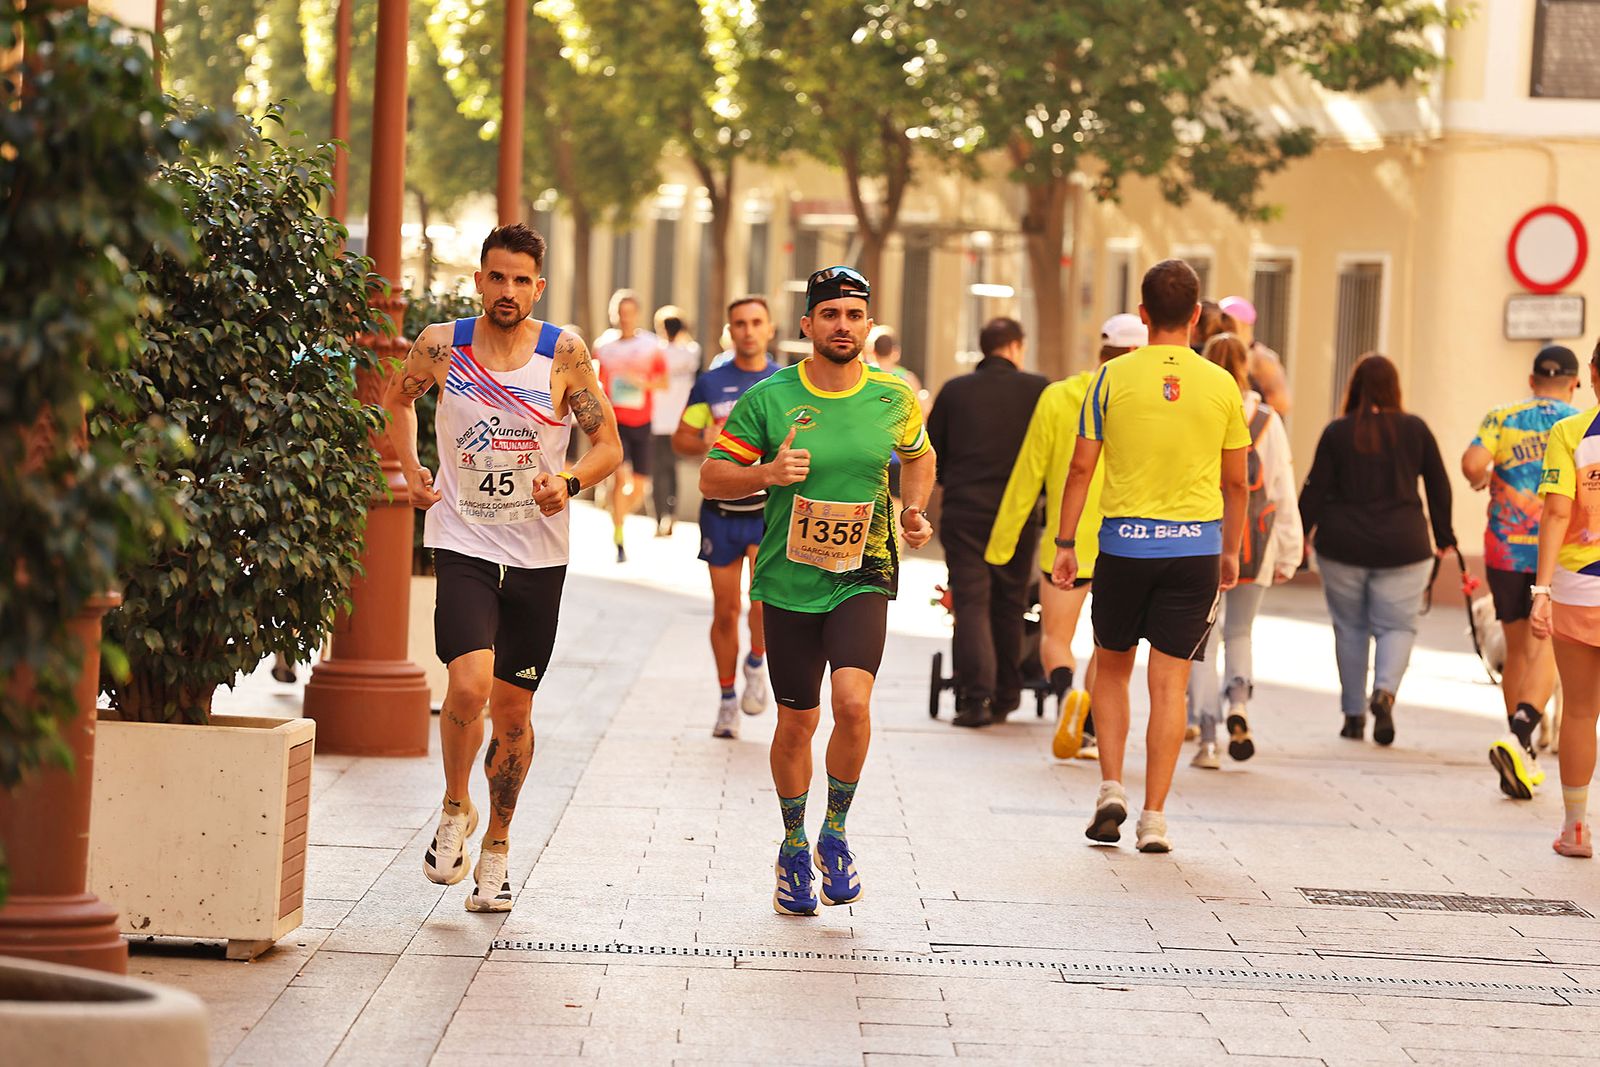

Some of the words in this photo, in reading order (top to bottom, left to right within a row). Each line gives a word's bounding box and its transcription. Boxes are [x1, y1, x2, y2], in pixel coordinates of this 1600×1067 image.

[456, 427, 475, 448] Jerez
[478, 472, 515, 496] 45
[459, 500, 491, 510] SANCHEZ
[492, 499, 534, 509] DOMINGUEZ
[460, 506, 496, 518] Huelva
[796, 517, 864, 546] 1358
[1118, 523, 1150, 539] C.D.
[1154, 523, 1202, 539] BEAS
